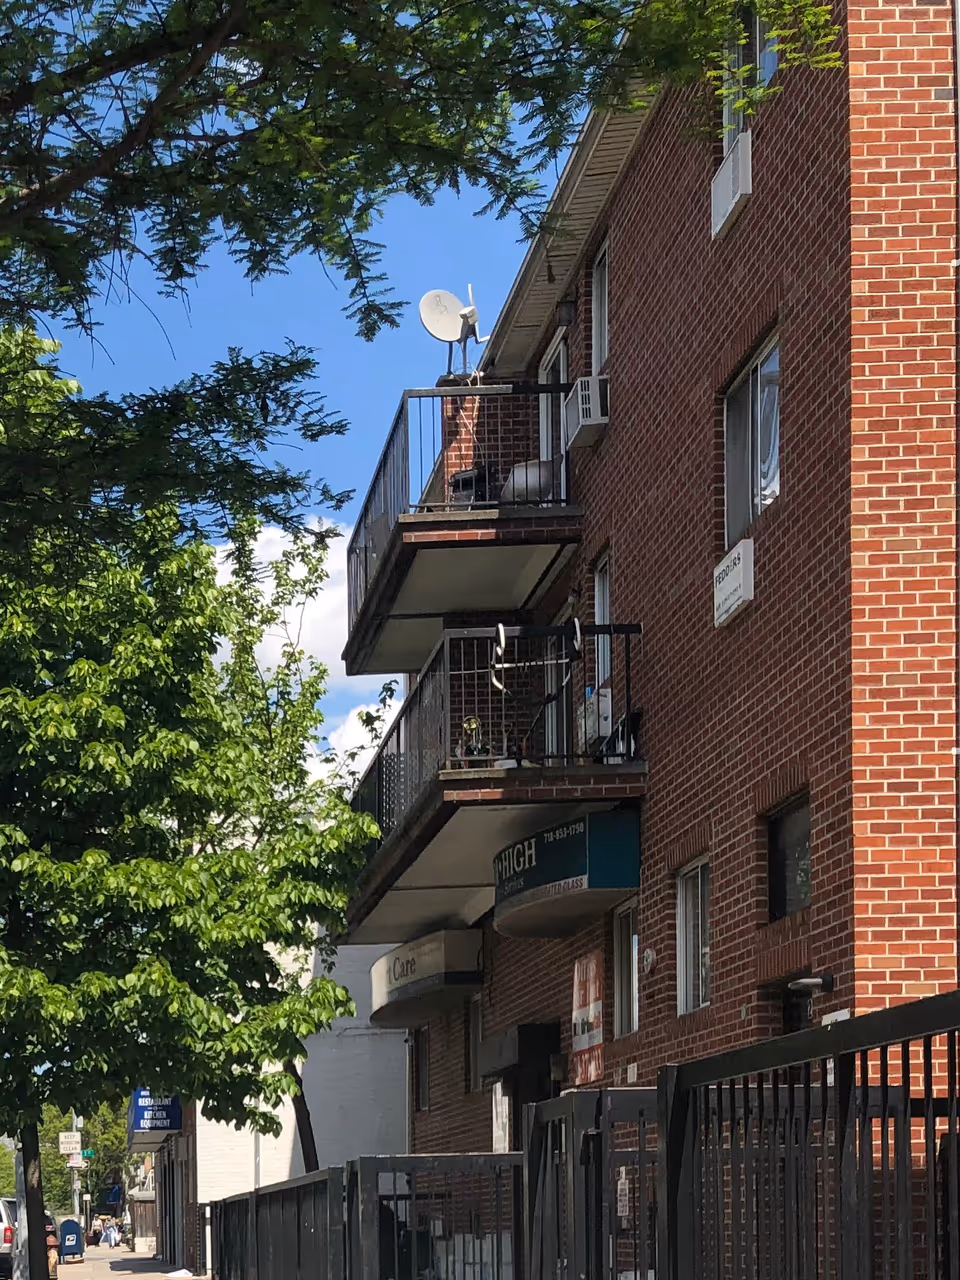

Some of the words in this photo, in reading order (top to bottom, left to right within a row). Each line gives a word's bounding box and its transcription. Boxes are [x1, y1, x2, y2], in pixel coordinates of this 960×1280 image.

[393, 956, 417, 981] Care
[138, 1097, 172, 1107] RESTAURANT
[144, 1110, 167, 1119] KITCHEN
[140, 1119, 171, 1129] EQUIPMENT
